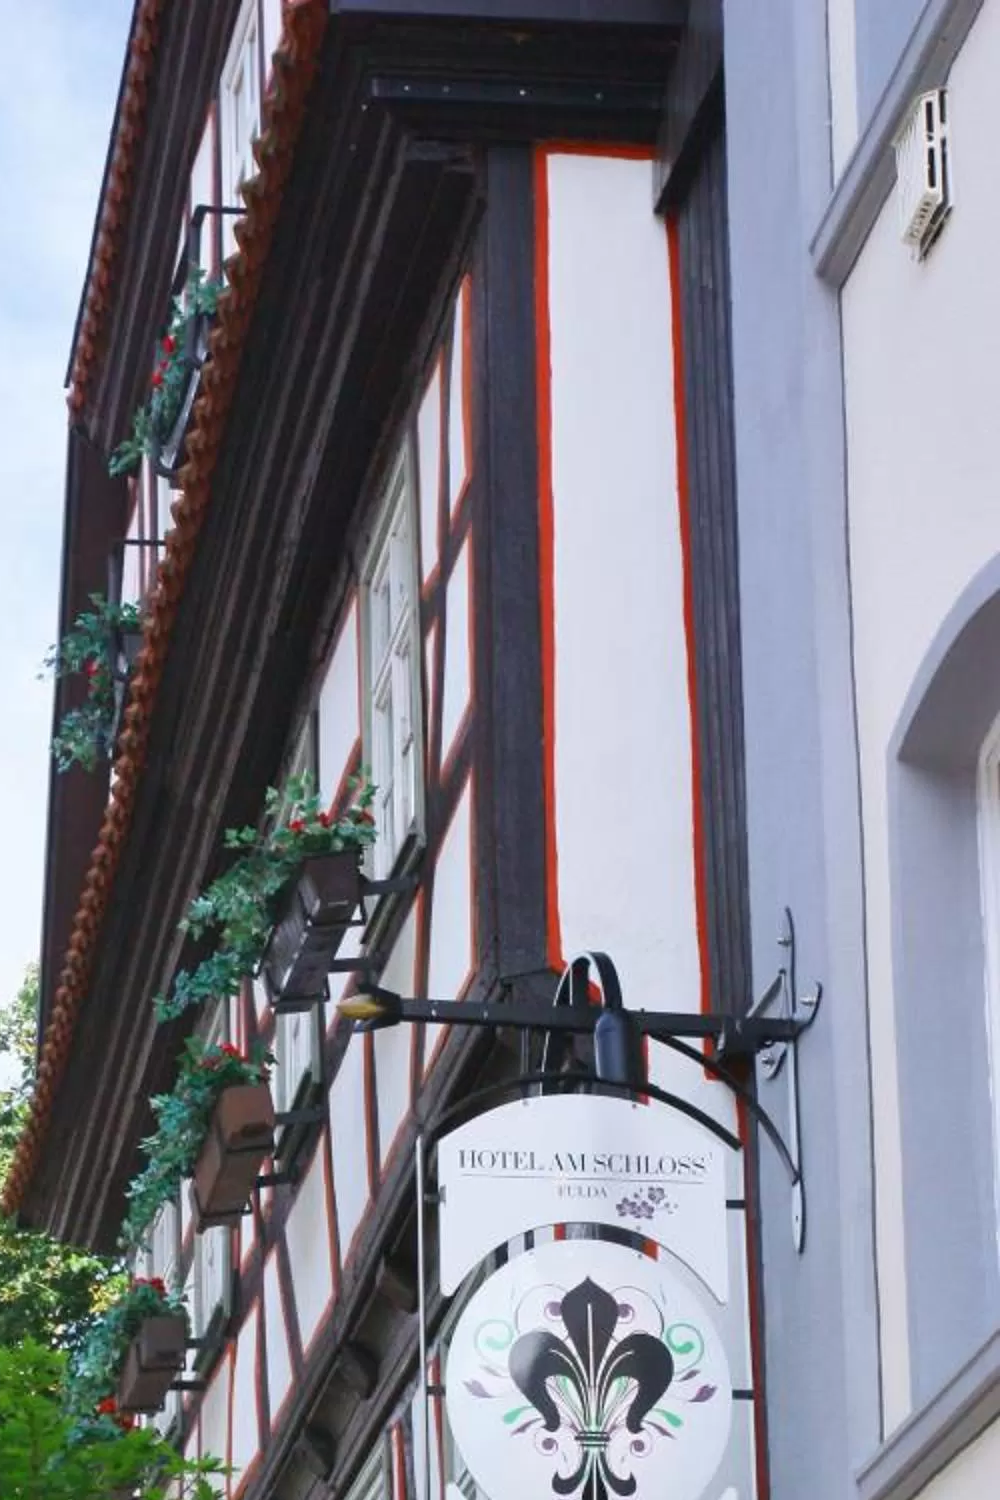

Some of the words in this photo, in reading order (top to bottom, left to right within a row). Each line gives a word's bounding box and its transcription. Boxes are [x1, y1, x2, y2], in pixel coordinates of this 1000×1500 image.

[459, 1149, 545, 1171] HOTEL
[549, 1152, 587, 1172] AM
[593, 1154, 706, 1176] SCHLOSS
[557, 1185, 608, 1198] FULDA
